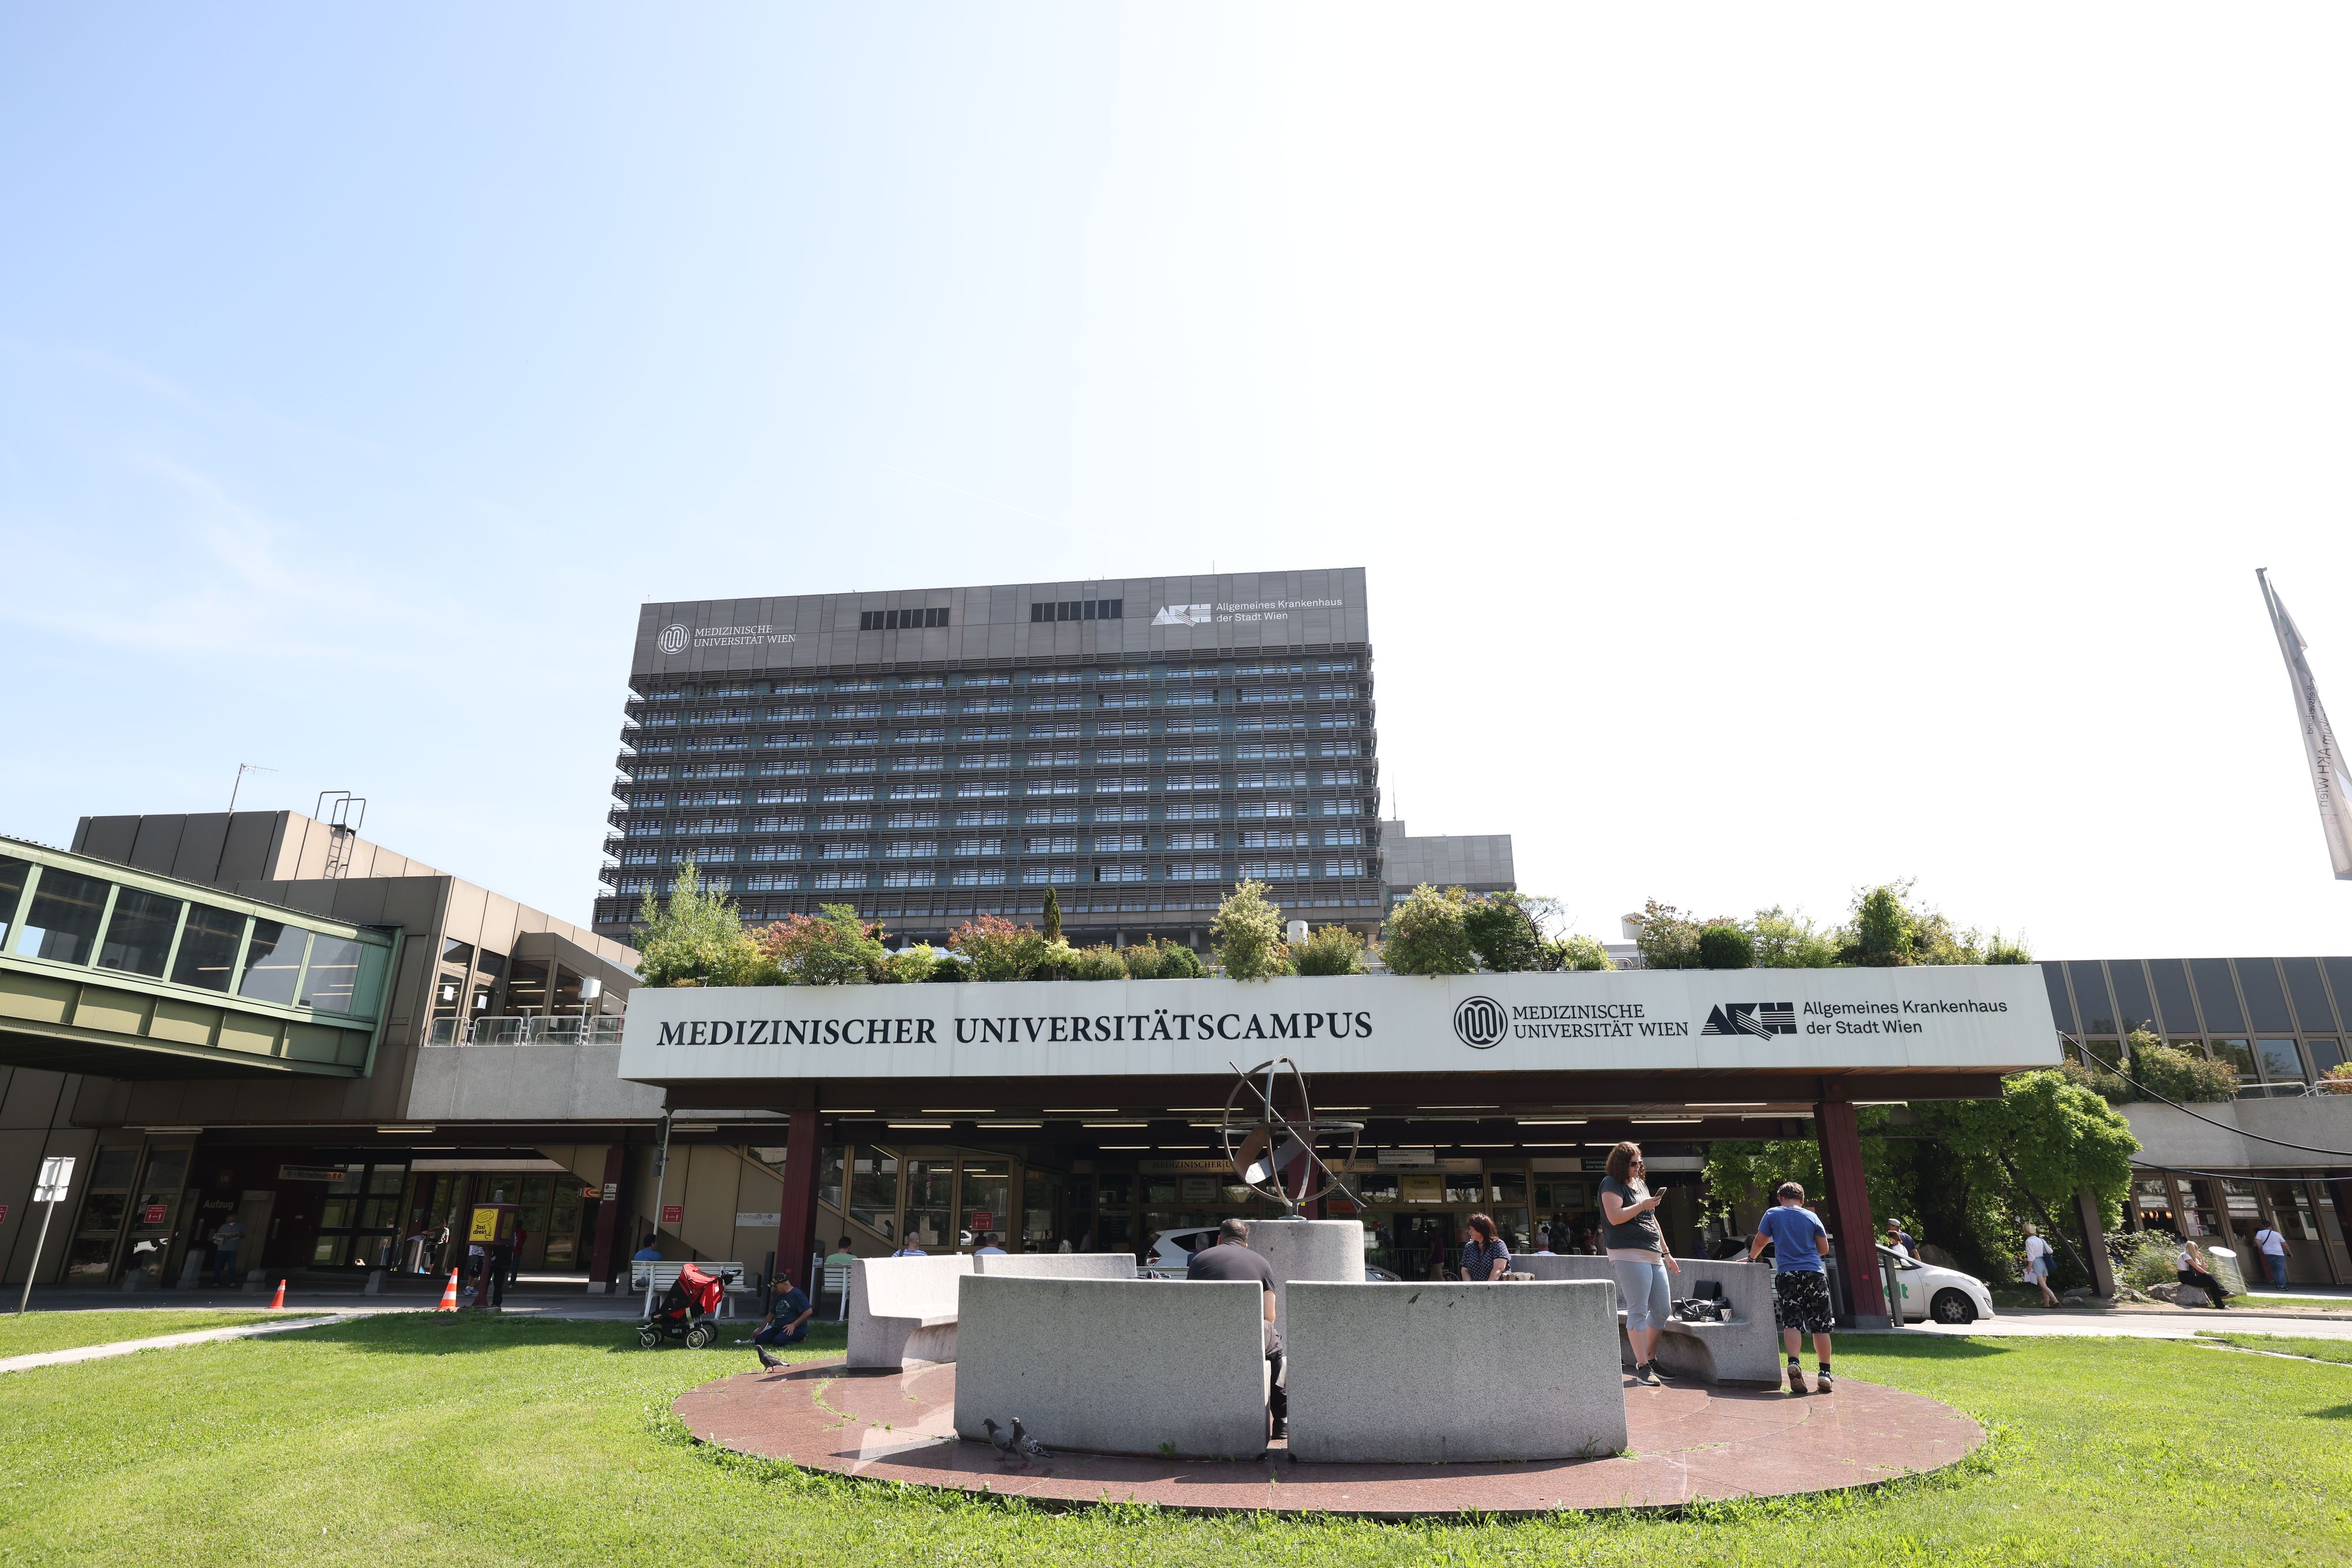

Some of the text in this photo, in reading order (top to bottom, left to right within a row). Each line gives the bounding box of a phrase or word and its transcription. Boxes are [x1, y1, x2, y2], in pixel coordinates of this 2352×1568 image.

[1216, 598, 1342, 613] Allgemeines Krankenhaus
[1217, 611, 1288, 622] der Stadt Wien
[694, 625, 773, 637] MEDIZINISCHE
[693, 634, 796, 647] UNIVERSITÄT WIEN
[1512, 1004, 1645, 1020] MEDIZINISCHE
[1803, 999, 2008, 1018] Allgemeines Krankenhaus
[656, 1009, 1373, 1046] MEDIZINISCHER UNIVERSITÄTSCAMPUS
[1514, 1020, 1689, 1038] UNIVERSITÄT WIEN
[1806, 1019, 1923, 1035] der Stadt Wien
[203, 1199, 235, 1211] Aufzug
